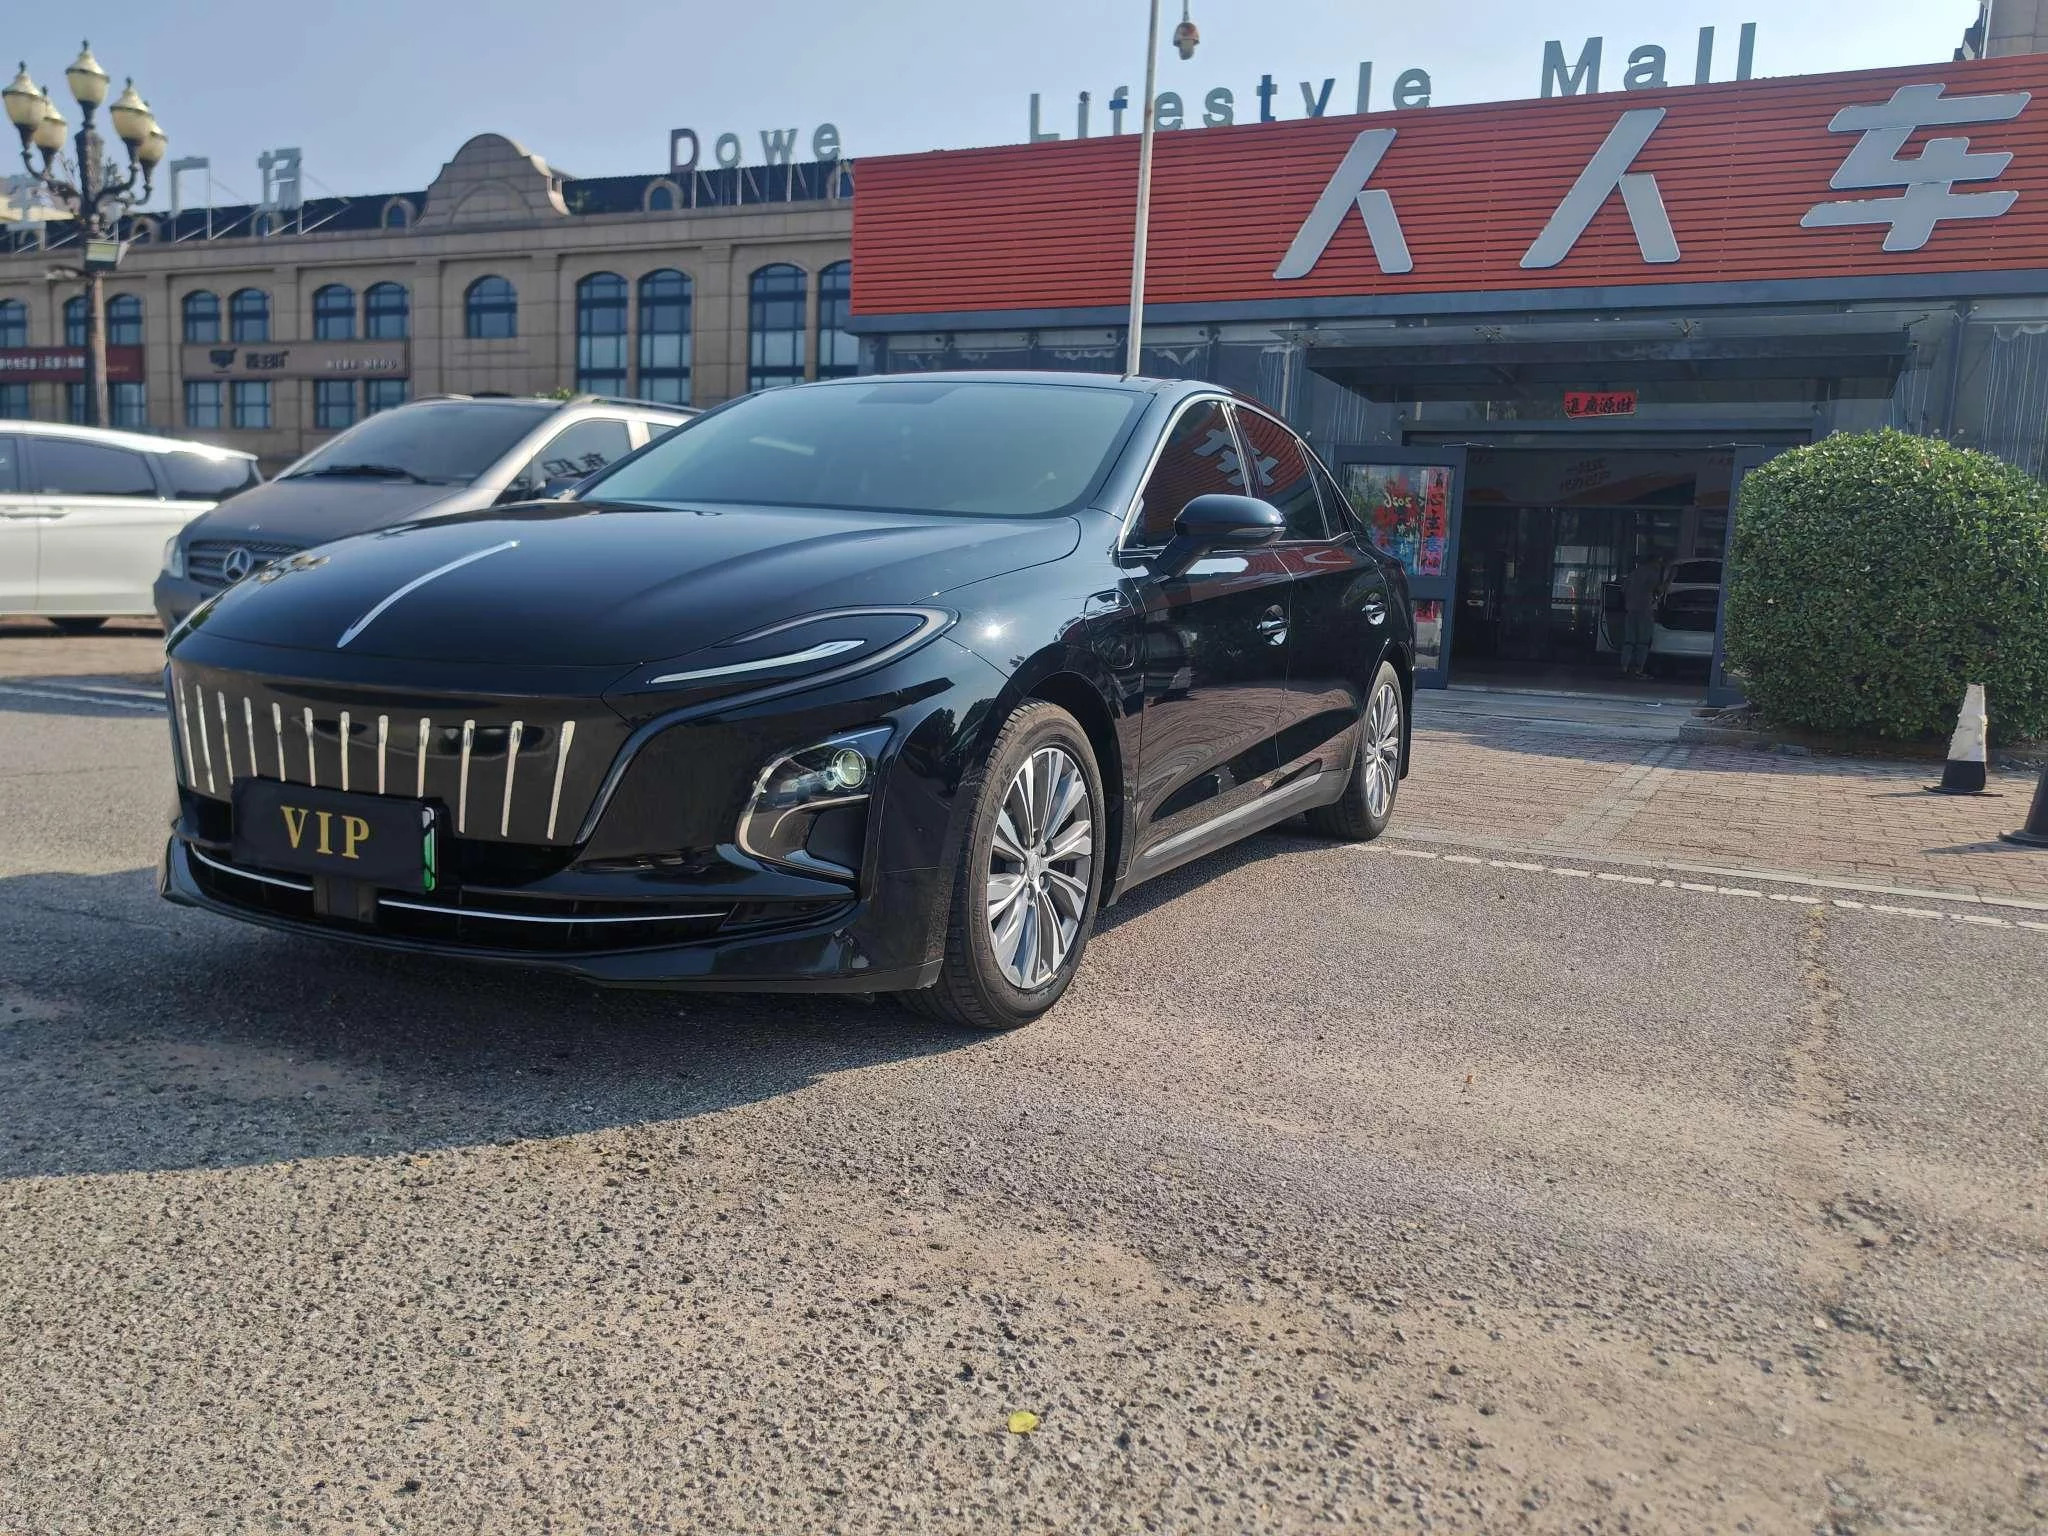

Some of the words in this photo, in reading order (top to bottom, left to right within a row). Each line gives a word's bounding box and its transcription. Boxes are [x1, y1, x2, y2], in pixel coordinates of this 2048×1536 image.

[671, 122, 841, 174] Dowe
[1029, 61, 1433, 144] Lifestyle
[1541, 22, 1757, 99] Mall
[1272, 82, 2033, 280] 人人车
[280, 805, 370, 859] VIP
